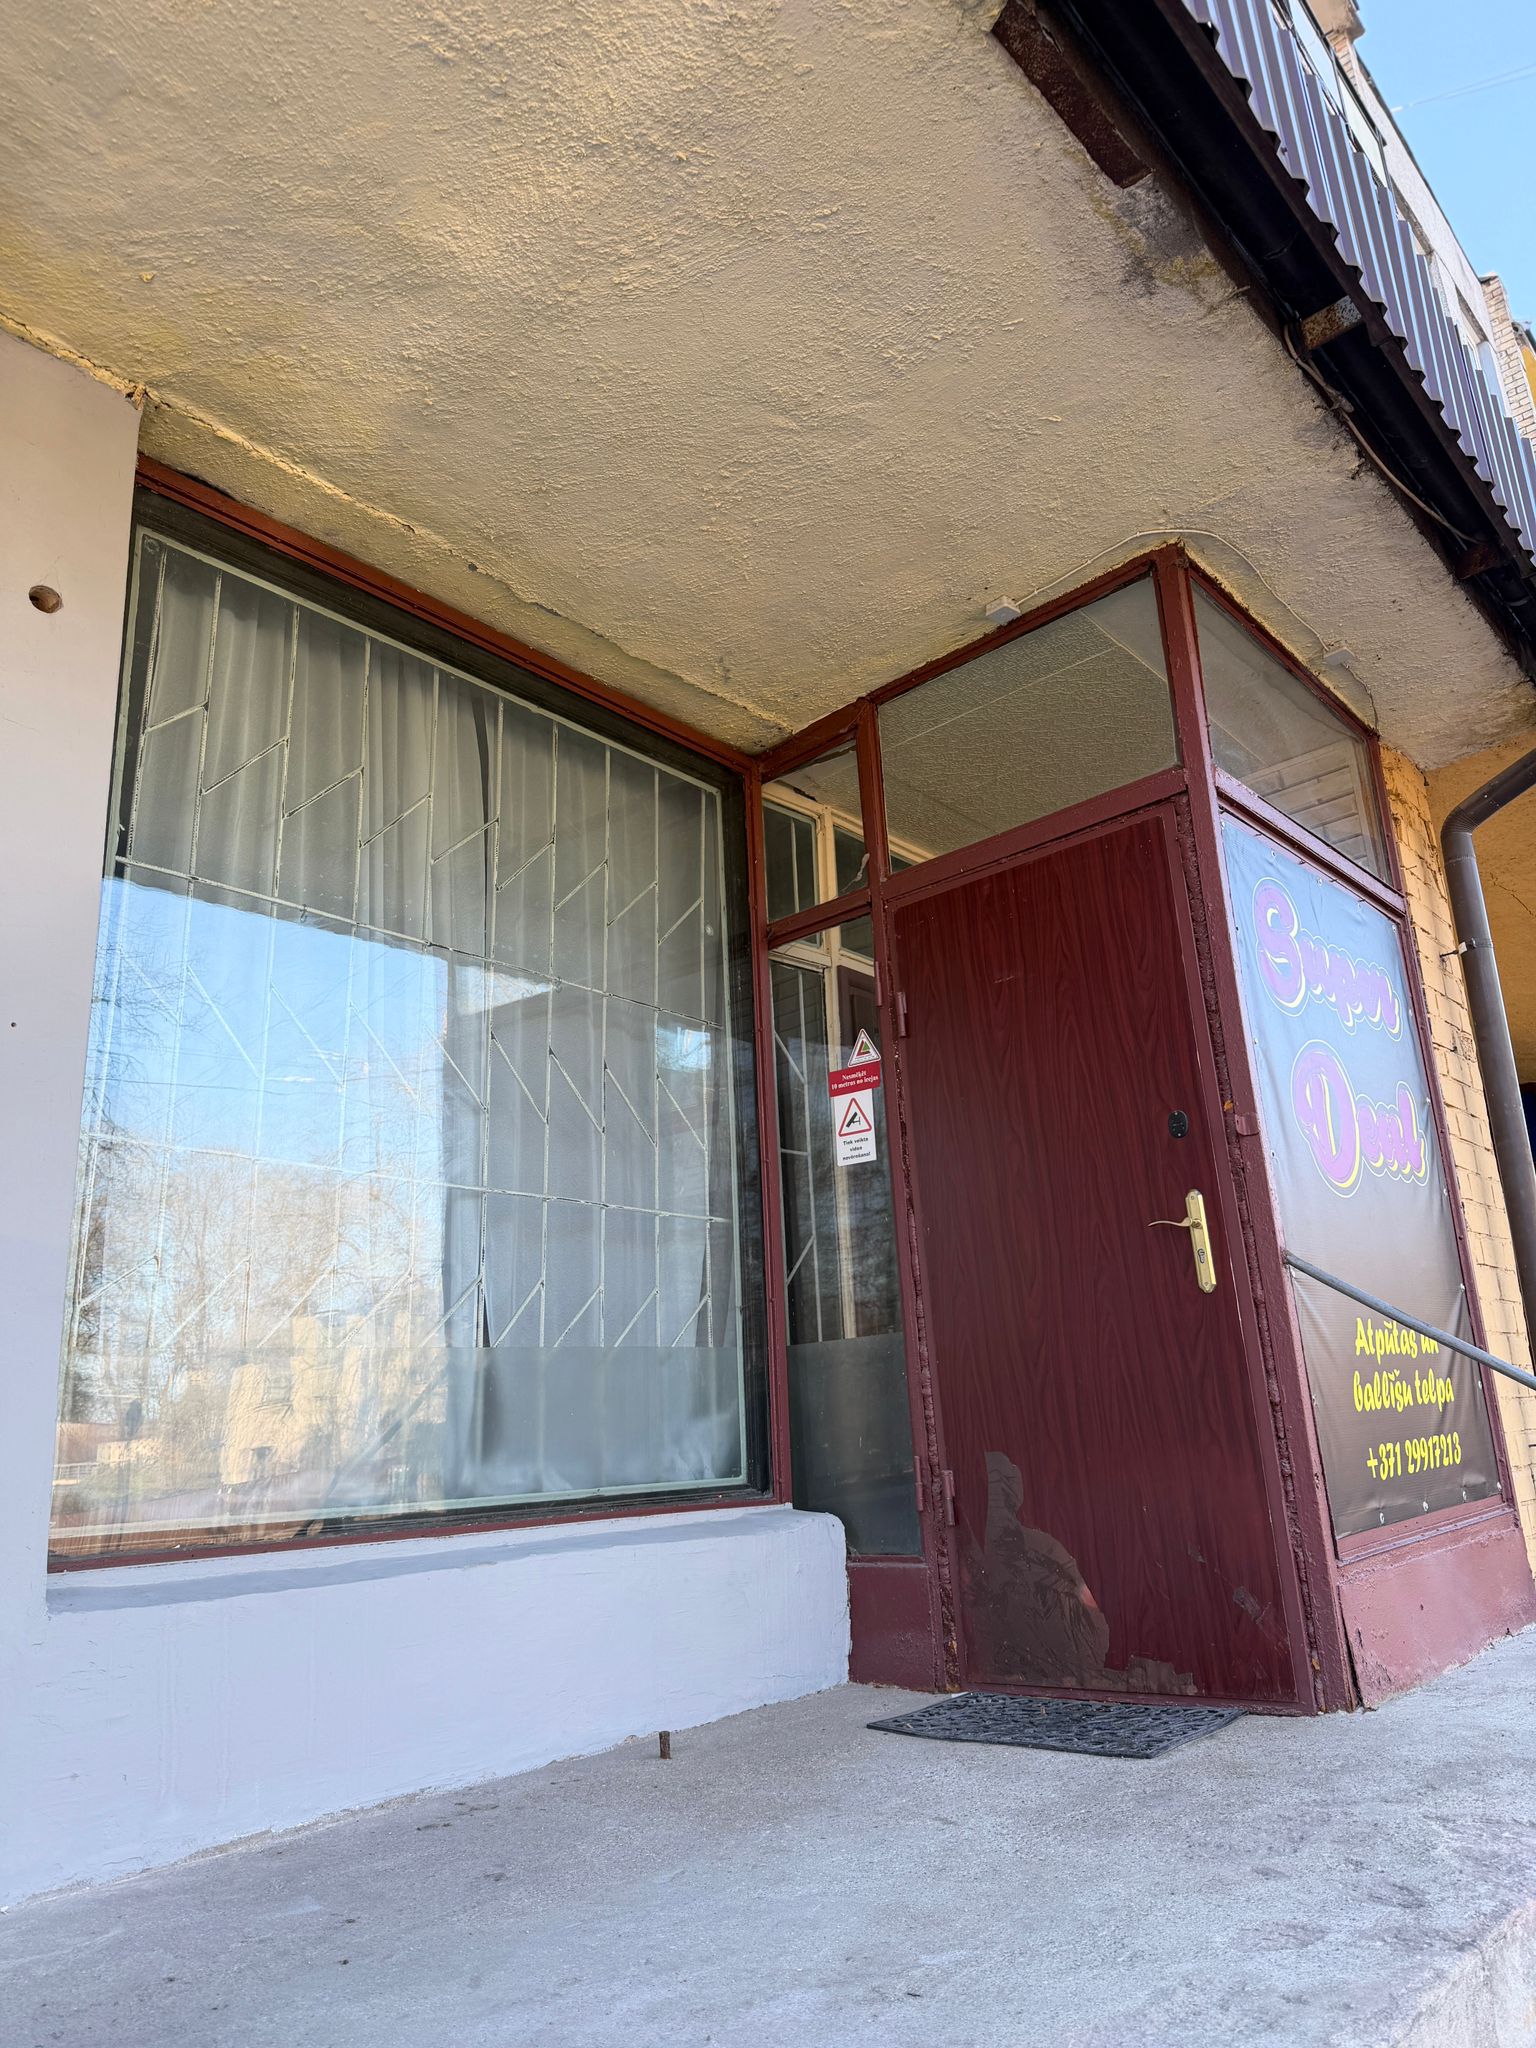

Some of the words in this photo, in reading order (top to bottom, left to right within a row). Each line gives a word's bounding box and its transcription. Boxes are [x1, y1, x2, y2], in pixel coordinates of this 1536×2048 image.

[1254, 880, 1401, 1037] Super
[838, 1081, 856, 1089] metrus
[1293, 1044, 1427, 1193] Deal
[1355, 1317, 1418, 1365] Atpūtas
[1420, 1334, 1440, 1354] un
[1353, 1369, 1414, 1412] ballīšu
[1415, 1368, 1455, 1412] telpa
[1366, 1441, 1402, 1481] +371
[1405, 1431, 1462, 1475] 29917213
